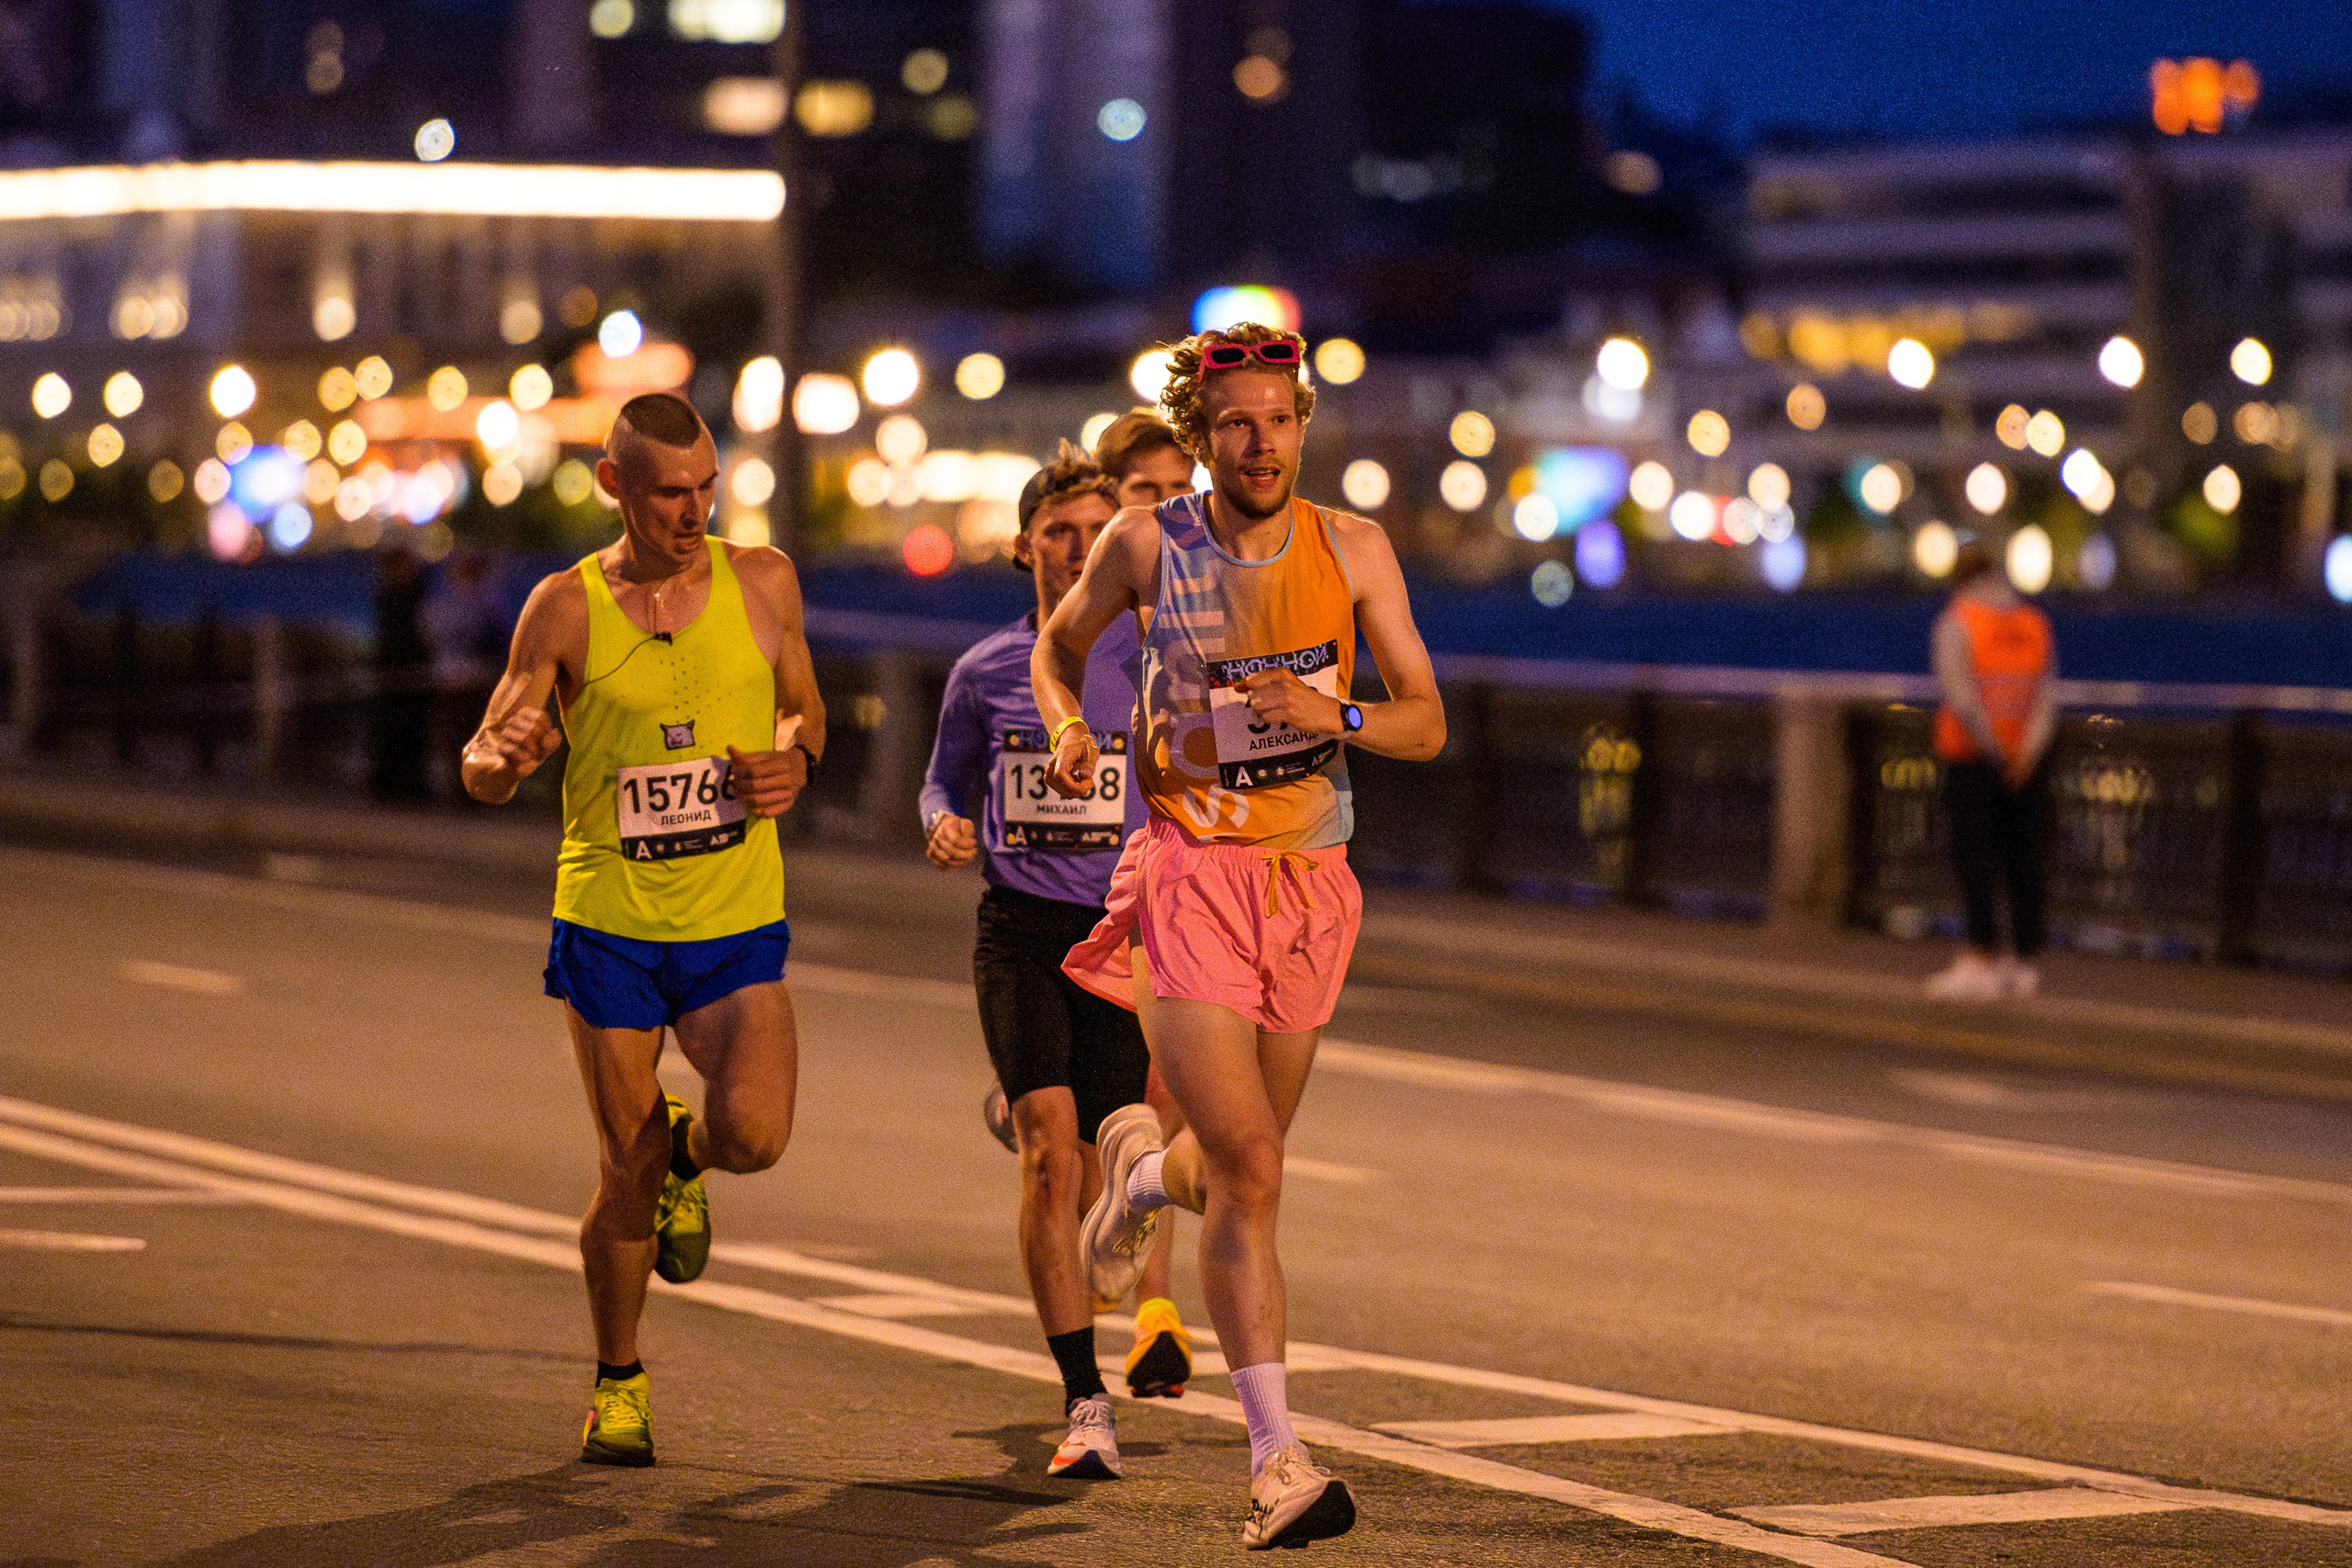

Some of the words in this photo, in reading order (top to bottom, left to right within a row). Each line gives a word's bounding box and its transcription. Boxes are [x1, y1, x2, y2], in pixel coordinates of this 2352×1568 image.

[1250, 731, 1317, 751] АЛЕКСАНД
[1012, 764, 1120, 801] 138
[661, 809, 712, 826] ЛЕОНИД
[1036, 804, 1087, 816] МИХАИЛ
